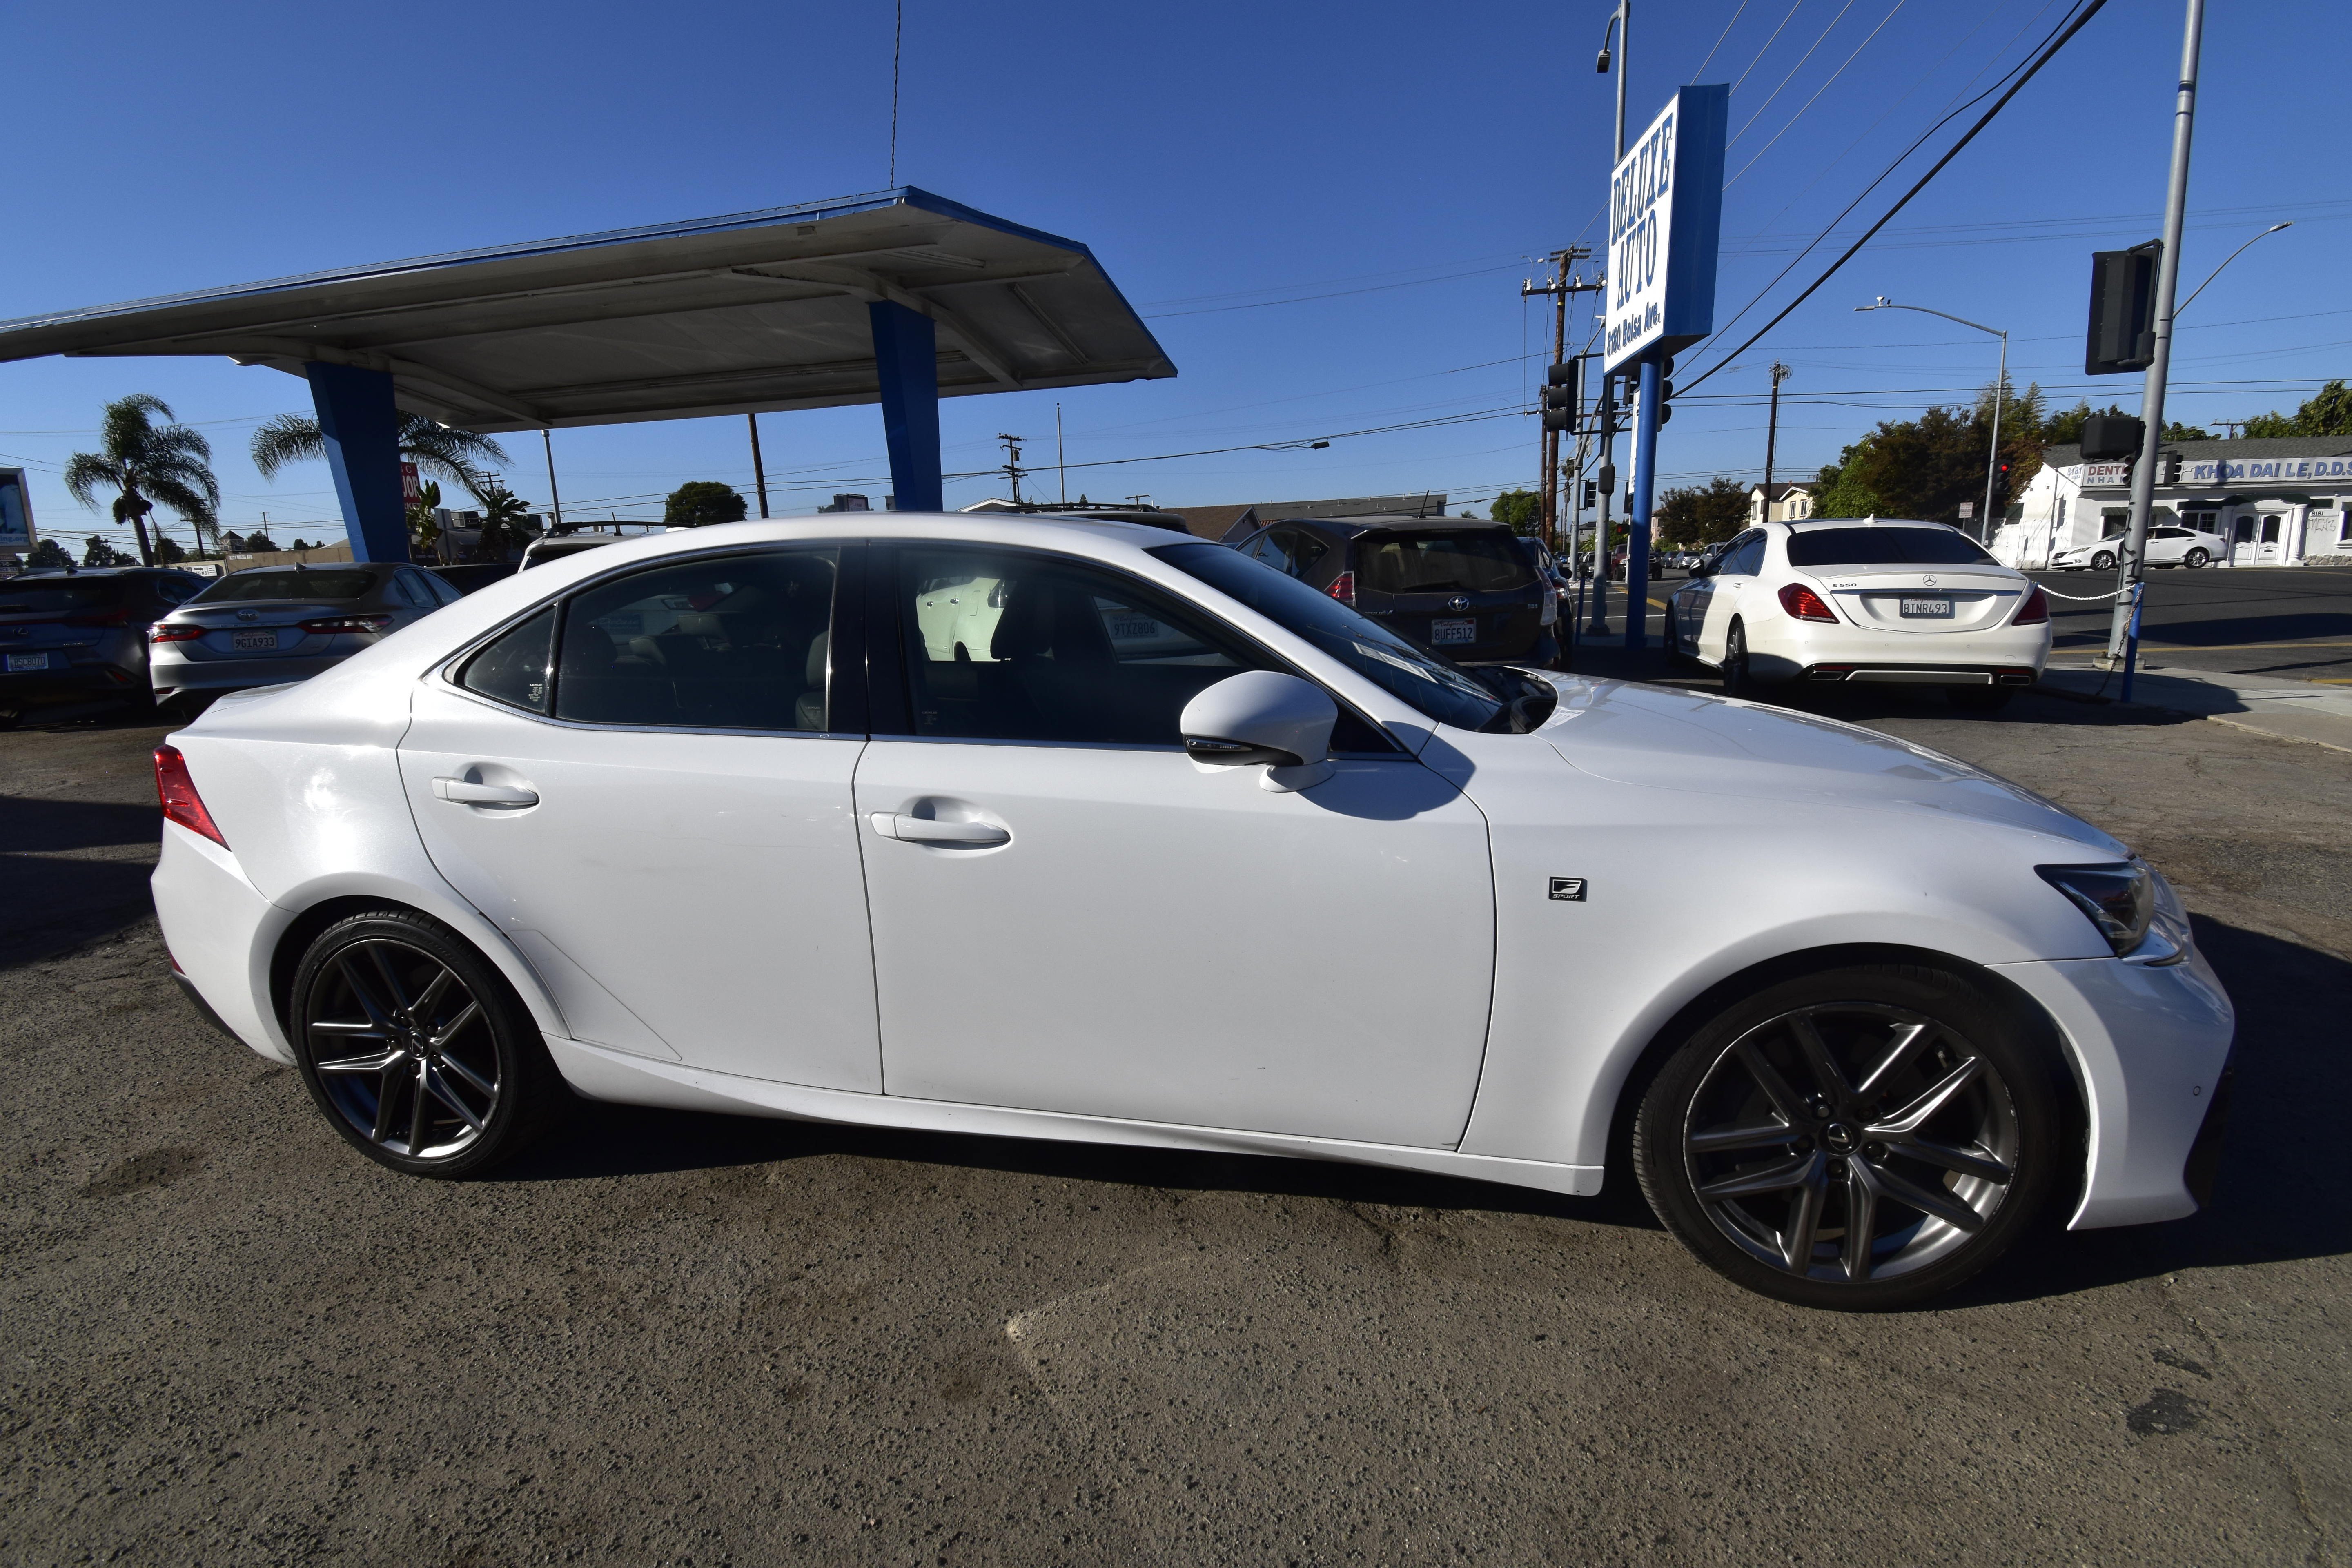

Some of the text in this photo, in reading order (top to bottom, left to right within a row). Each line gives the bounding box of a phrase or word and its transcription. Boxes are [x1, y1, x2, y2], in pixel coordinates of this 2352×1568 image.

[1611, 113, 1673, 247] DELUXE
[1616, 209, 1657, 311] AUTO
[1607, 301, 1661, 358] 8180 Bolsa Ave.
[2193, 464, 2244, 479] KHOA
[2249, 463, 2281, 478] DAI
[2285, 462, 2312, 479] LE,
[2087, 476, 2114, 484] NHA
[1903, 603, 1947, 614] 8TNR493
[1114, 621, 1155, 636] 9TXZ806
[1434, 627, 1473, 640] 8UFF512
[235, 637, 275, 648] 9GIA933
